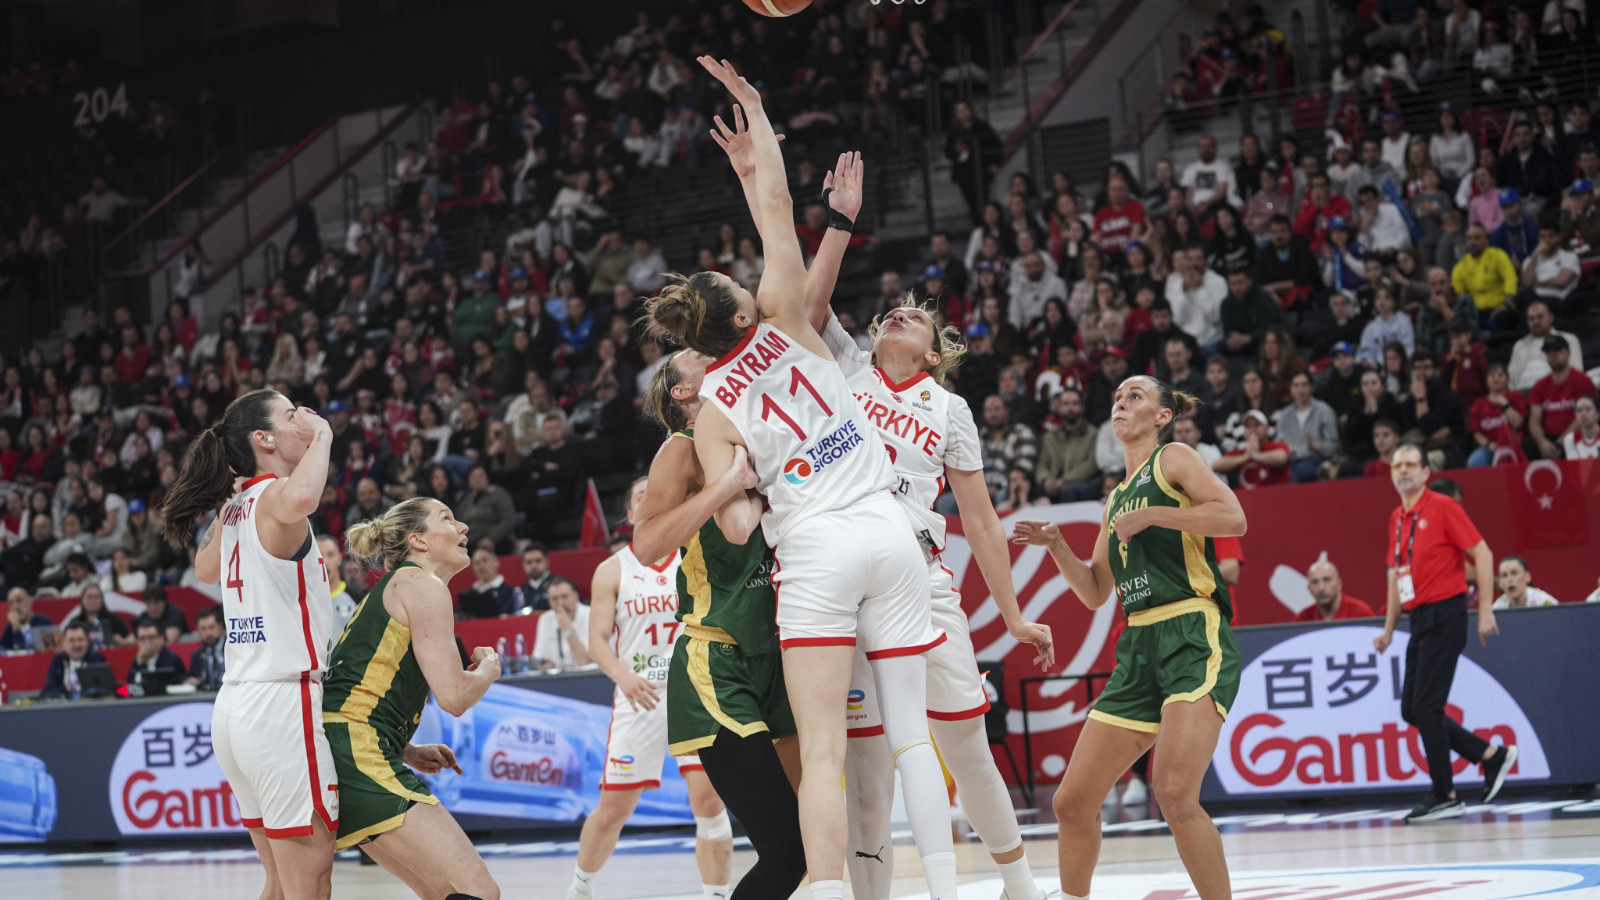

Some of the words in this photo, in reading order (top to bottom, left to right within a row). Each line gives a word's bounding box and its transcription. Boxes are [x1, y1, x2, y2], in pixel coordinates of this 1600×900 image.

[73, 82, 129, 127] 204
[715, 330, 791, 409] BAYRAM
[761, 365, 834, 442] 11
[853, 391, 942, 457] ÜRKİYE
[806, 419, 857, 461] TÜRKİYE
[226, 539, 244, 603] 4
[645, 622, 680, 646] 17
